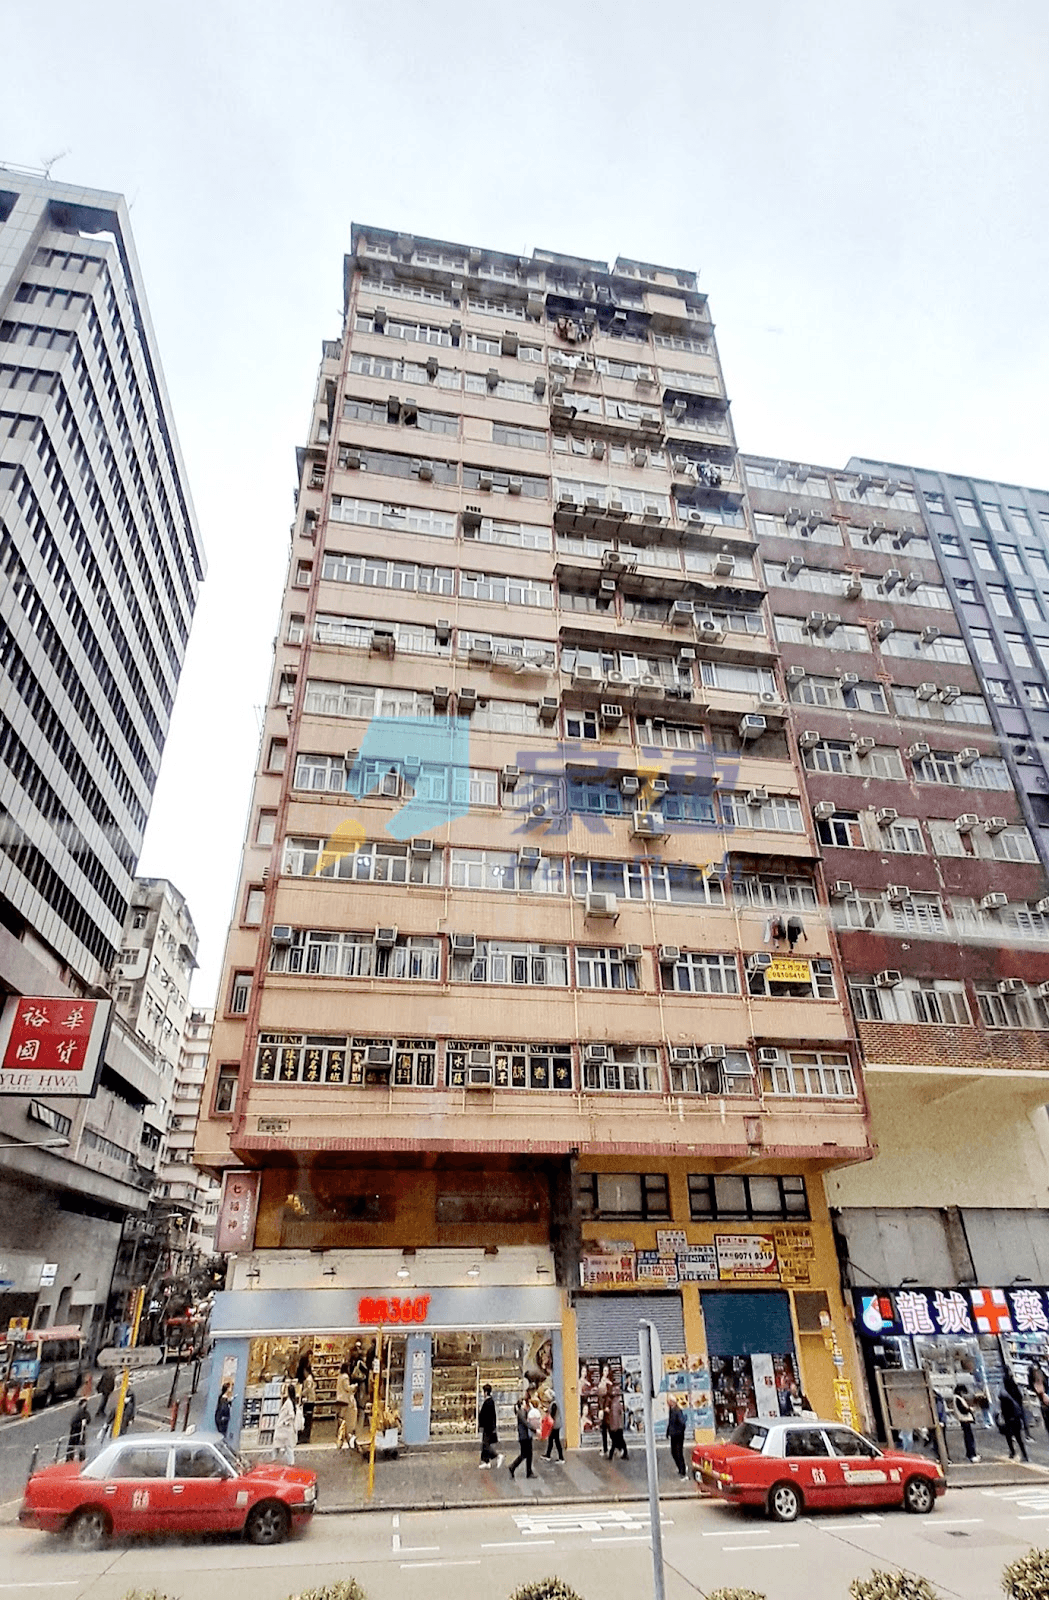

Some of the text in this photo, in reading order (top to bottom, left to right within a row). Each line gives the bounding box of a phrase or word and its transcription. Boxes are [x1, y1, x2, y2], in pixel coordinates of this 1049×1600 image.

[21, 1006, 84, 1030] 裕華
[16, 1039, 78, 1064] 國貨
[39, 1075, 78, 1086] HWA
[895, 1289, 1049, 1335] 龍城 藥
